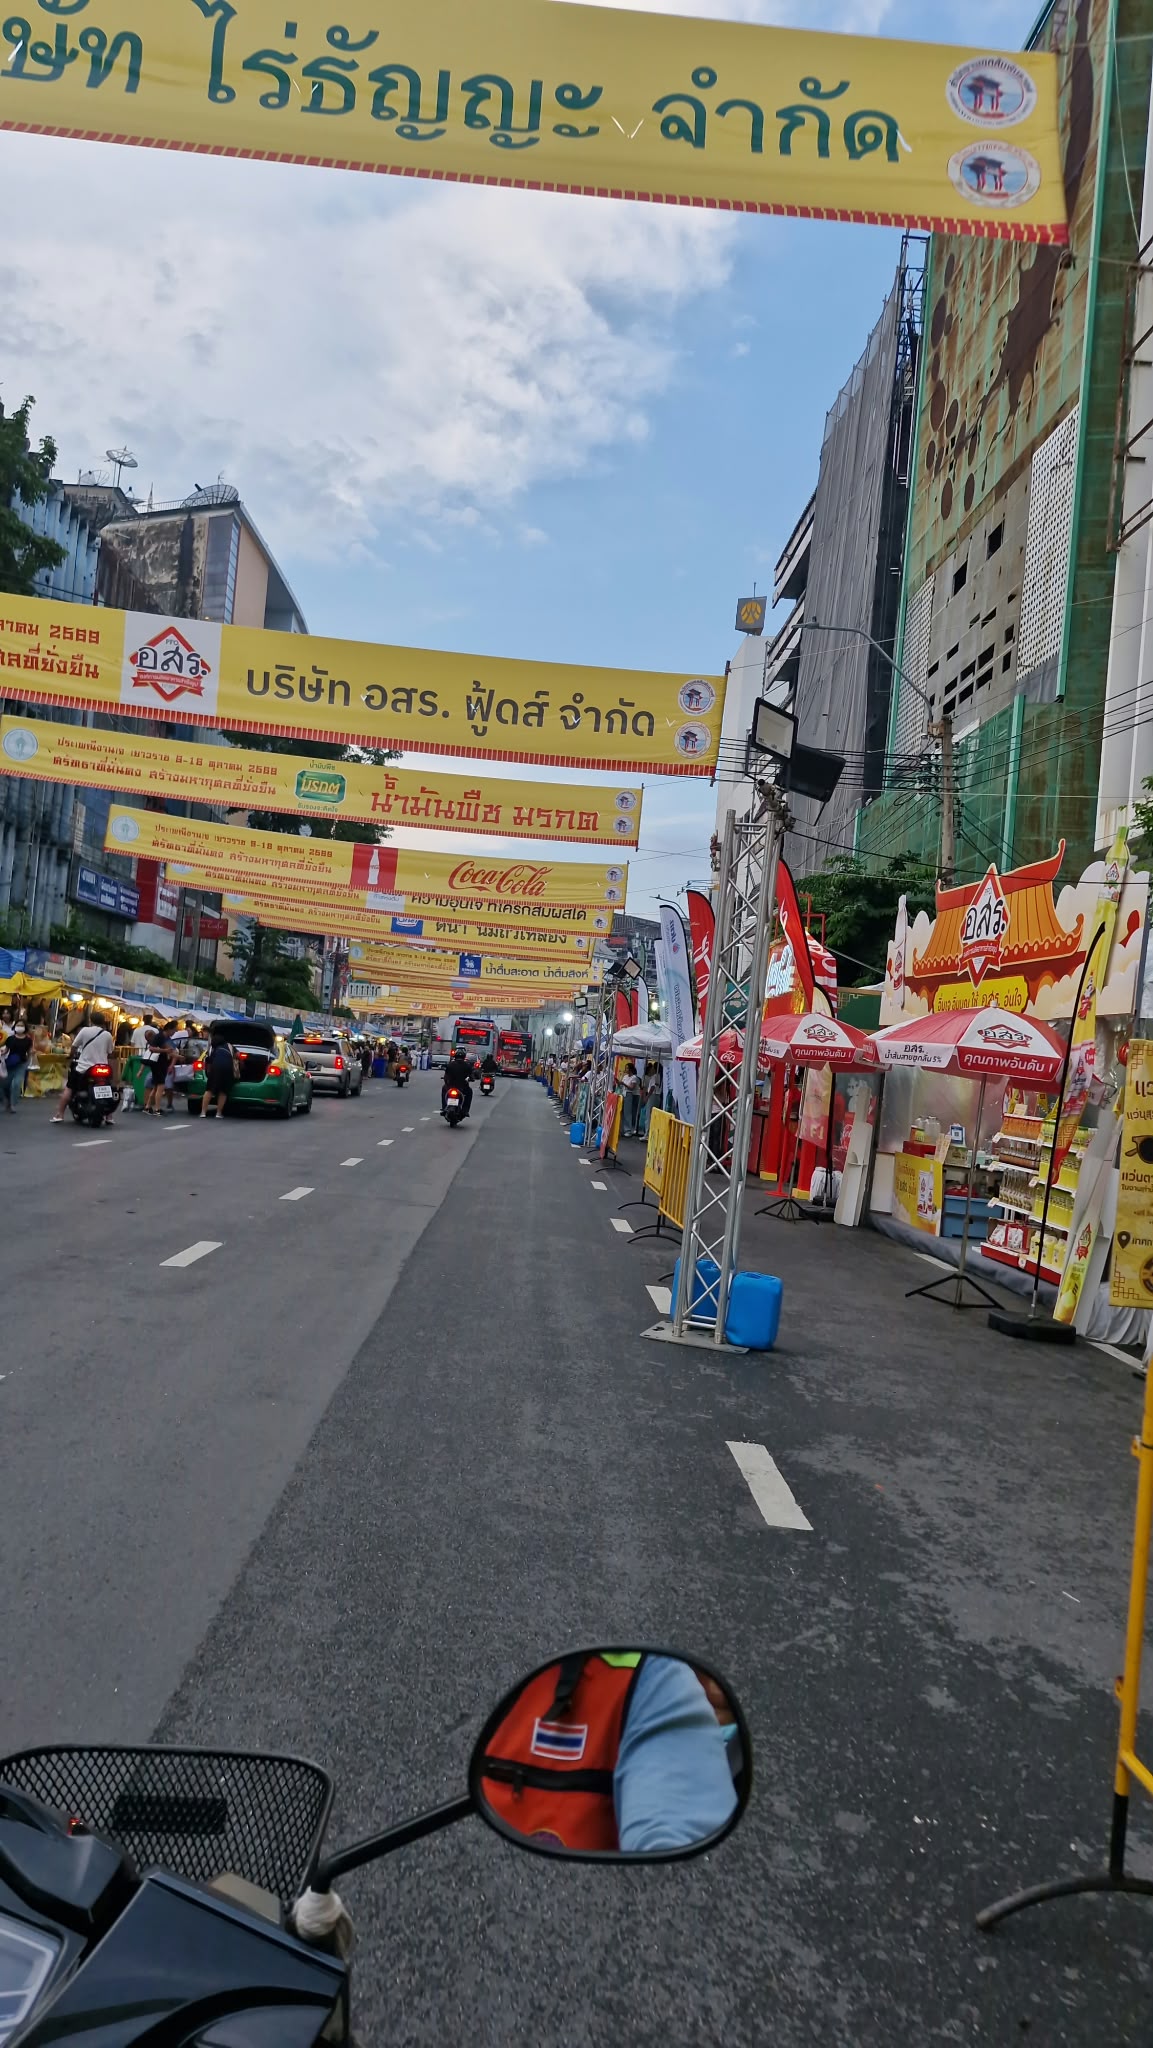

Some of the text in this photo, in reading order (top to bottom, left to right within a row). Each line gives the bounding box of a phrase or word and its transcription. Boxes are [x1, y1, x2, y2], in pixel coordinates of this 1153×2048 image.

[652, 66, 901, 163] จำกัด
[136, 646, 208, 676] อสร.
[246, 664, 655, 737] บริษัท อสร. ฟู้ดส์ จำกัด
[371, 773, 600, 831] น้ำมันพืช มรกต
[448, 860, 552, 896] Coca-Cola
[963, 896, 1006, 941] อสร.
[485, 963, 589, 979] น้ำดื่มสะอาด น้ำดื่มสิงห์
[795, 1047, 846, 1059] คุณภาพอันดับ
[904, 1044, 925, 1053] อสร.
[963, 1054, 1045, 1072] คุณภาพอันดับ
